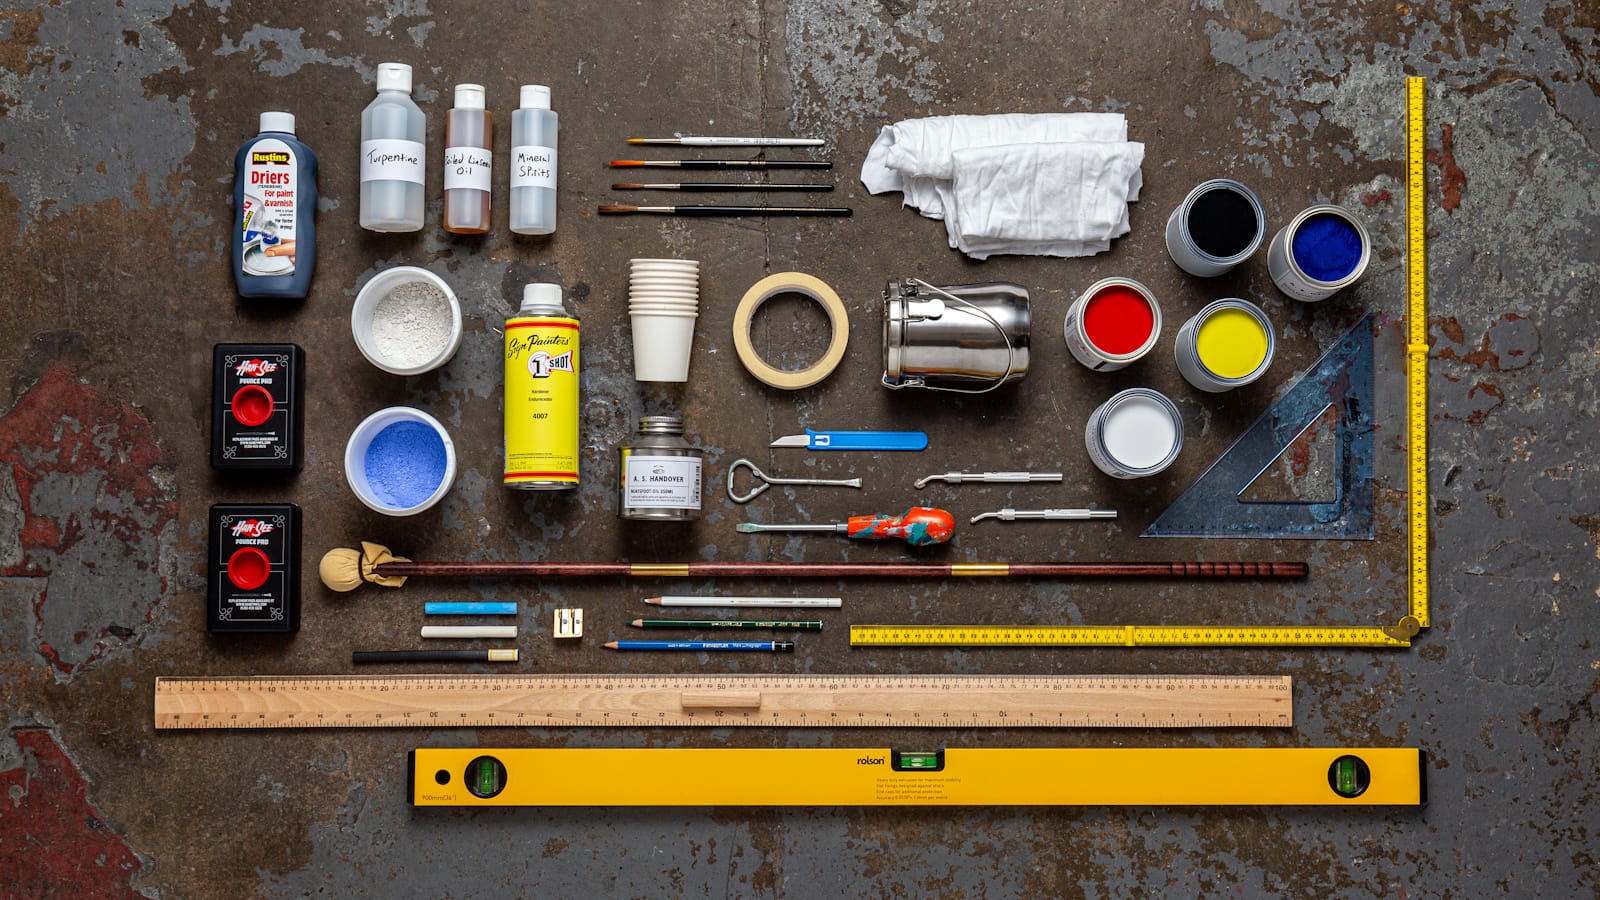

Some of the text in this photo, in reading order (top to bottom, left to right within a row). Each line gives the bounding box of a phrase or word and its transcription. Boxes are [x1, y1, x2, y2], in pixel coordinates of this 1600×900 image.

[253, 153, 287, 162] Rustins
[367, 149, 418, 165] Turpentine
[517, 152, 550, 163] Mineral
[456, 166, 472, 176] Oil
[251, 170, 290, 184] Driers
[276, 189, 294, 198] paint
[507, 337, 527, 360] Sign
[532, 354, 569, 379] 1 SHOT
[857, 755, 885, 765] rolson
